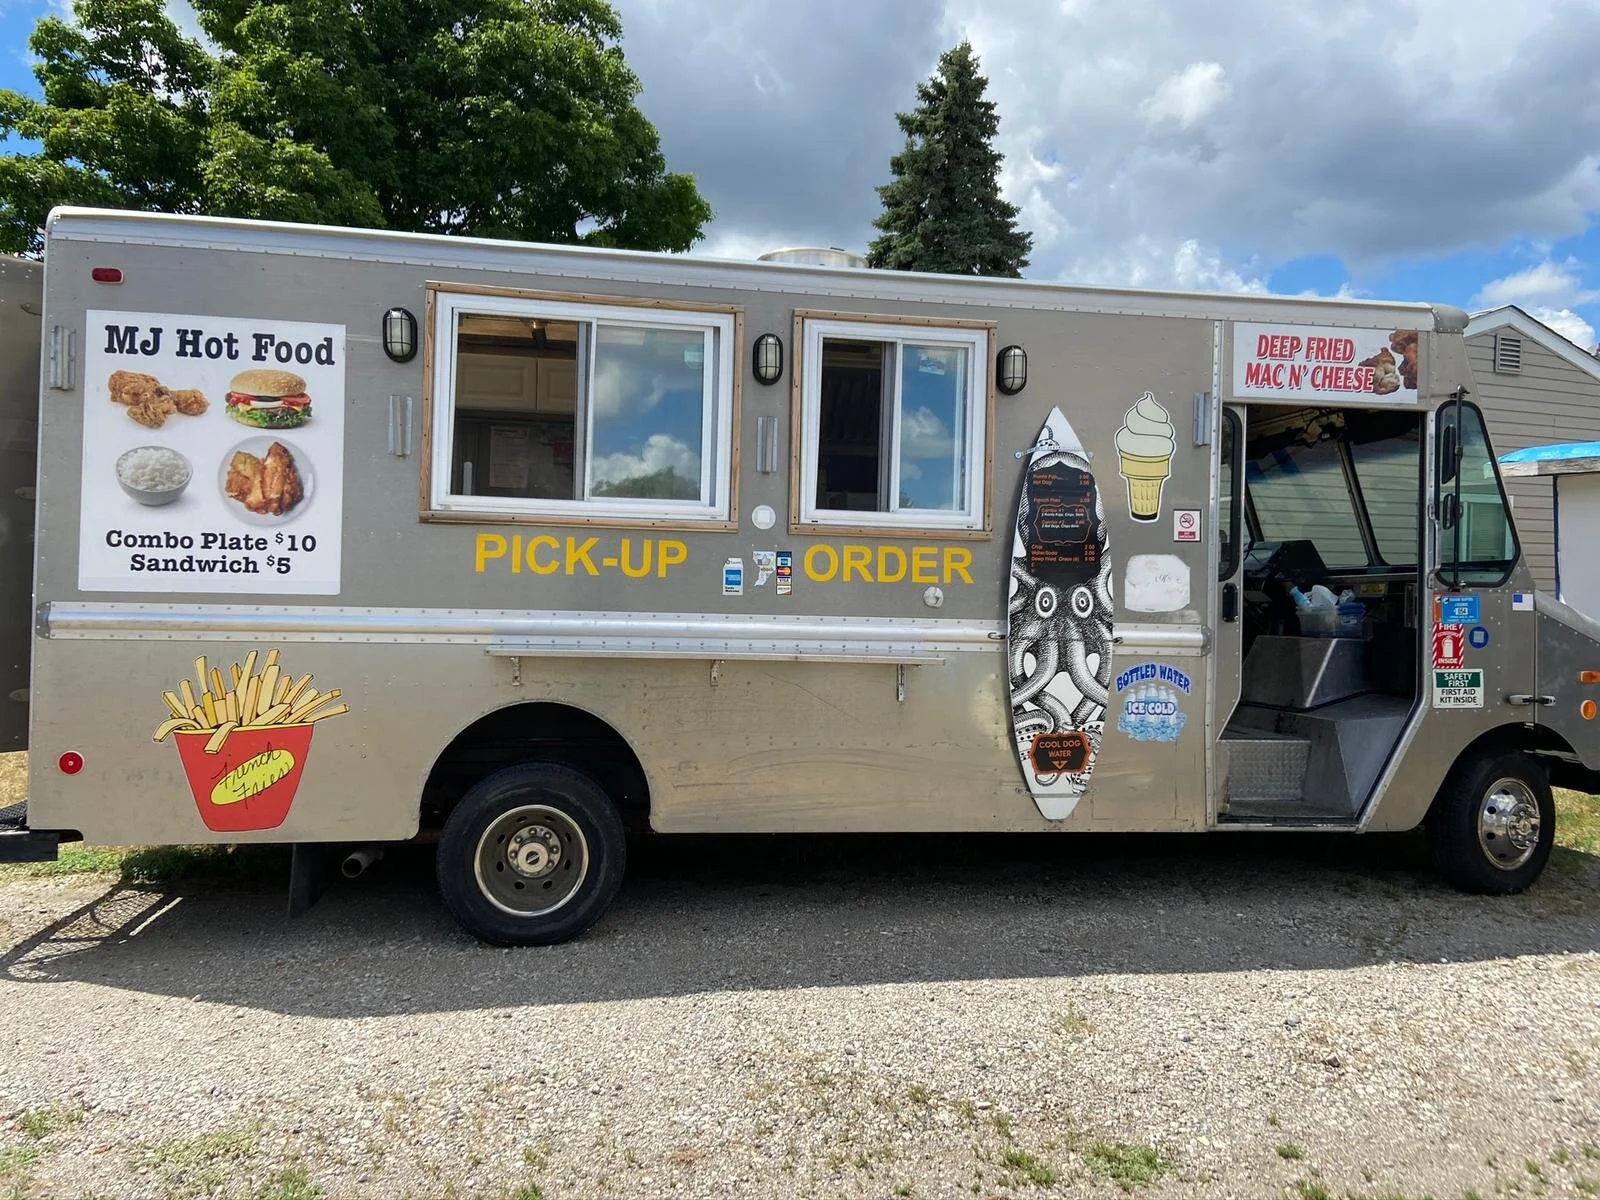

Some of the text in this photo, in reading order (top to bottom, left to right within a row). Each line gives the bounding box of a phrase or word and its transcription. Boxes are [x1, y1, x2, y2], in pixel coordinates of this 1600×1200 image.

[104, 324, 335, 366] MJ Hot Food
[1256, 334, 1356, 363] DEEP FRIED
[1244, 362, 1286, 390] MAC
[1310, 364, 1376, 393] CHEESE
[105, 529, 317, 553] Combo Plate $10
[130, 554, 291, 575] Sandwich $5
[475, 532, 688, 578] PICK-UP
[803, 543, 974, 584] ORDER
[1438, 622, 1457, 631] FIRE
[1116, 663, 1190, 694] BOTTLED WATER
[1127, 701, 1176, 715] ICE COLD
[1039, 740, 1081, 749] COOL DOG
[1048, 750, 1072, 758] WATER
